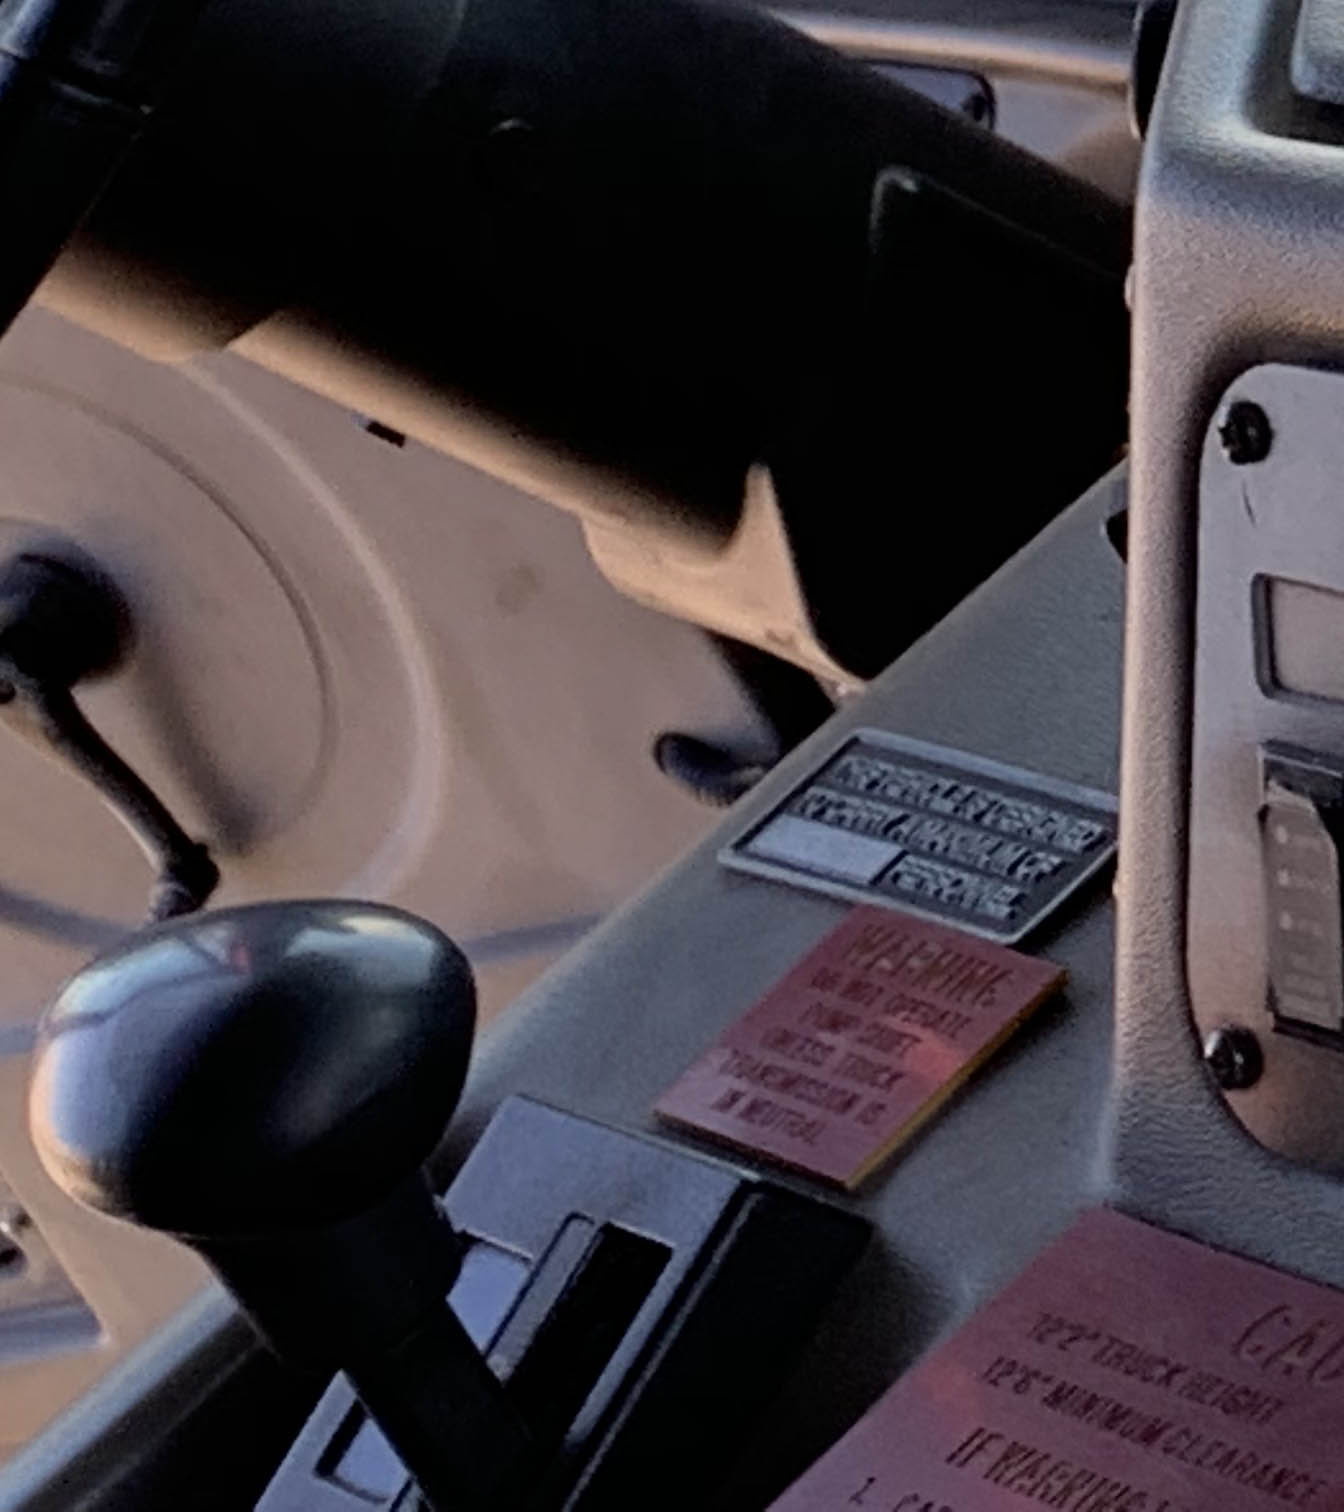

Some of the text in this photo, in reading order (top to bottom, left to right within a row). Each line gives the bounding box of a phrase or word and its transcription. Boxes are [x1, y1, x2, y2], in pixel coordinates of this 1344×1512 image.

[843, 922, 1014, 1008] WARNING
[883, 992, 975, 1039] OPERATE
[718, 1048, 890, 1127] TRANSMISSION IS
[833, 1051, 903, 1091] TRUCK
[737, 1096, 827, 1146] NEUTRAL
[1091, 1334, 1189, 1392] TRUCK
[1179, 1368, 1287, 1426] HEIGHT
[944, 1426, 1004, 1469] IF
[1042, 1379, 1168, 1450] MINIMUM
[1158, 1426, 1327, 1504] CLEARANCE
